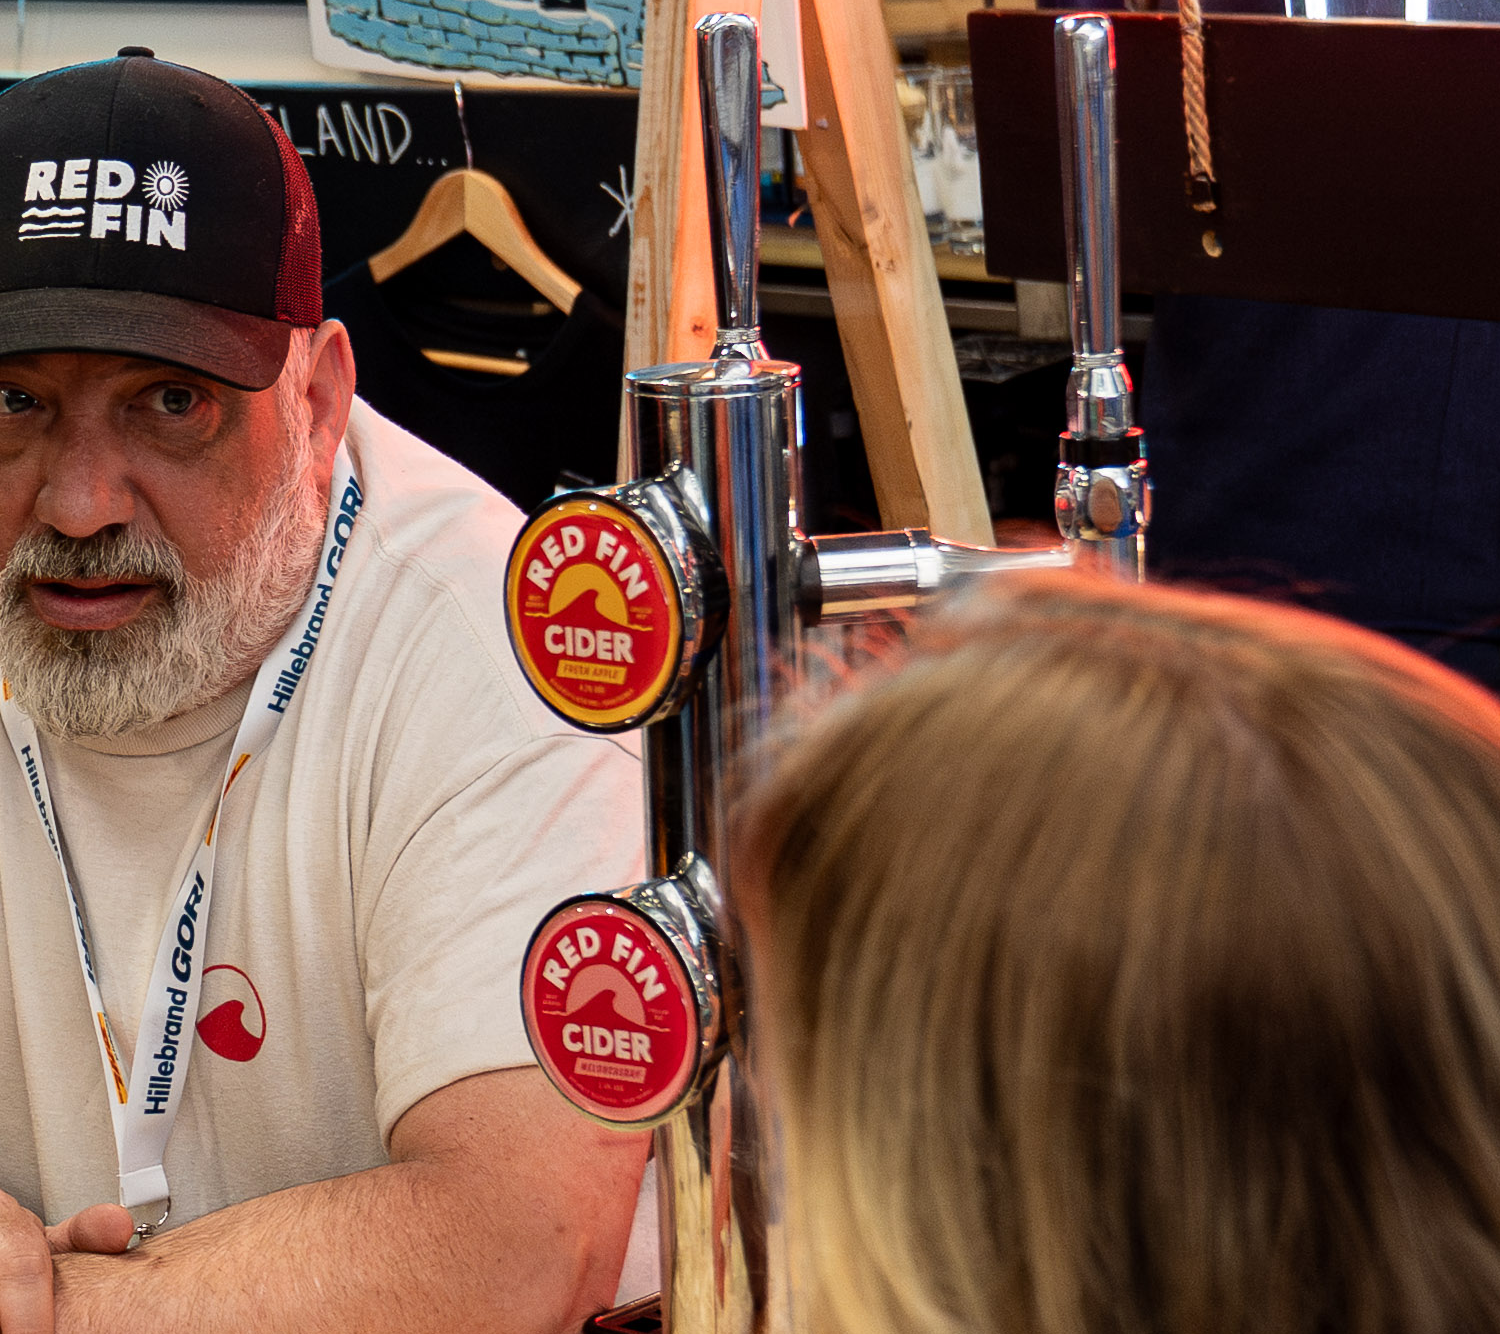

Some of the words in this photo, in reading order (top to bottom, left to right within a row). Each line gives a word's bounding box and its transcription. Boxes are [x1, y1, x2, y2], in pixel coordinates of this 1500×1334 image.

[23, 156, 132, 204] RED
[89, 202, 190, 252] FIN
[525, 524, 587, 592] RED
[595, 530, 650, 601] FIN
[266, 582, 334, 715] Hillebrand
[327, 474, 364, 581] GORI
[543, 623, 636, 665] CIDER
[143, 986, 188, 1116] Hillebrand
[169, 869, 206, 985] GORI
[541, 926, 601, 992] RED
[610, 932, 667, 1003] FIN
[561, 1022, 655, 1064] CIDER
